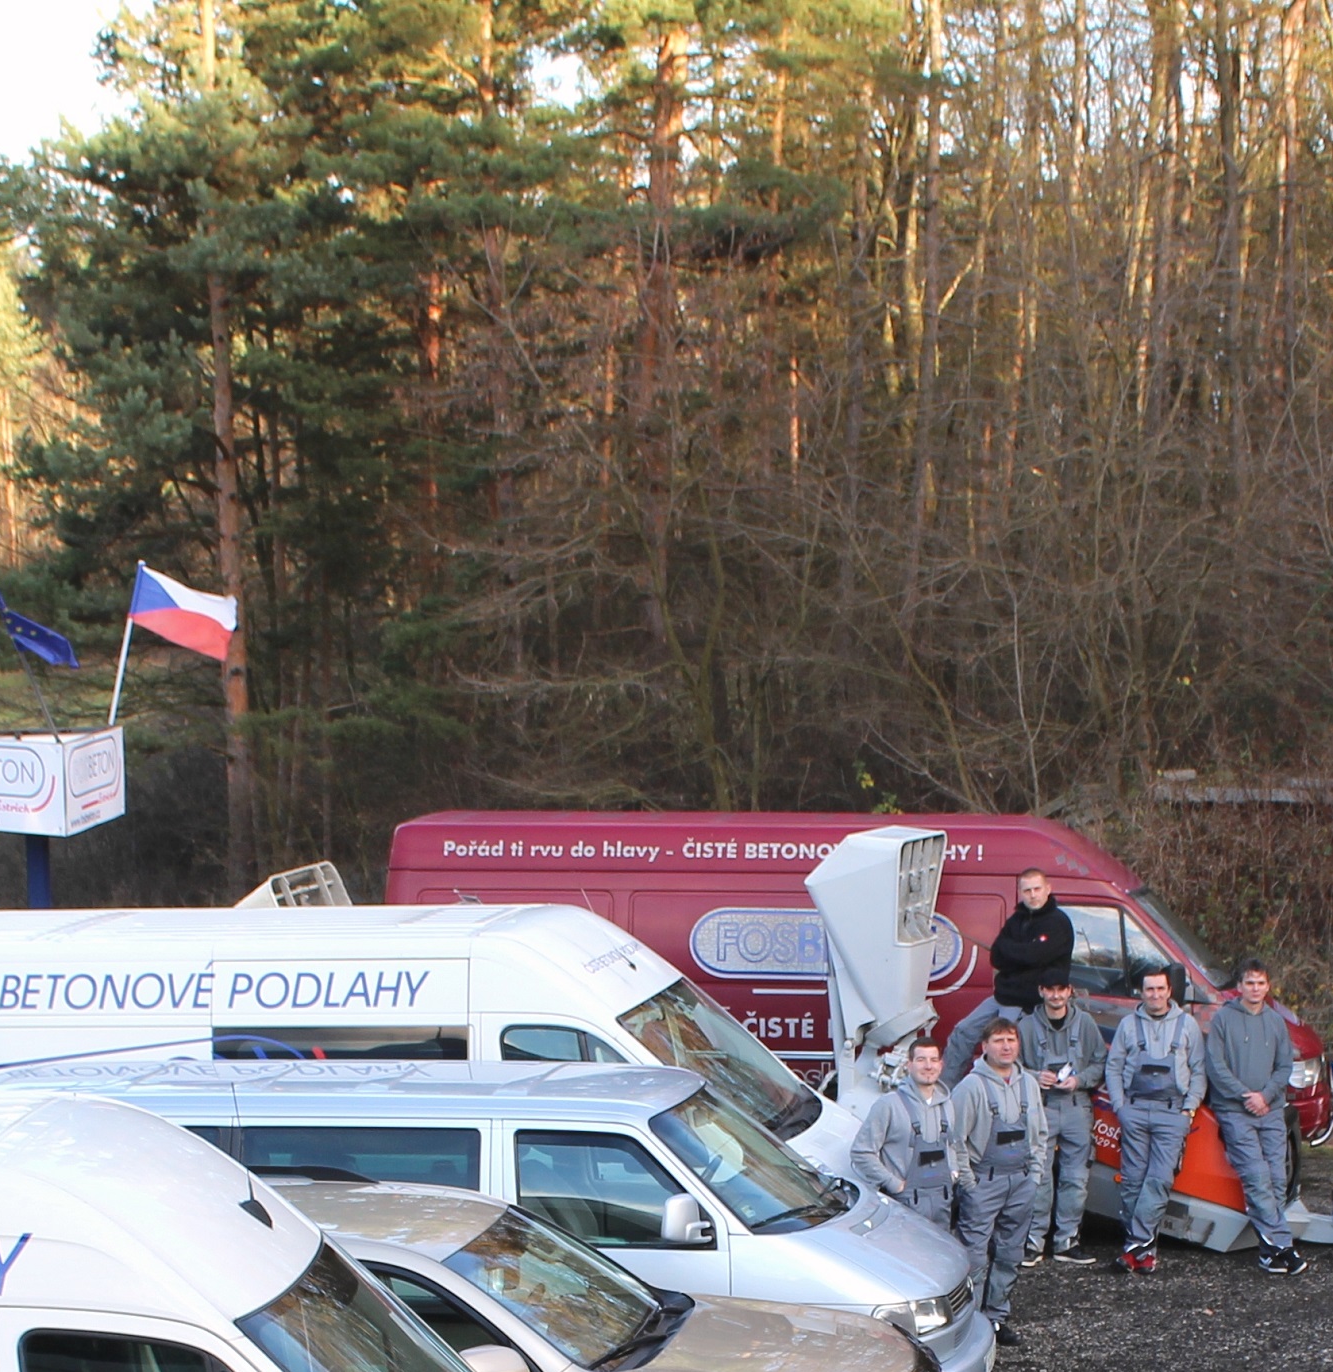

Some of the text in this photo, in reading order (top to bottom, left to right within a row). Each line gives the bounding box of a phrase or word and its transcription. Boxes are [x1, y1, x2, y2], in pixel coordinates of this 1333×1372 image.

[443, 839, 504, 857] Pořád
[510, 840, 524, 857] ti
[530, 844, 564, 858] rvu
[570, 840, 596, 858] do
[602, 840, 660, 862] hlavy
[682, 836, 737, 859] ČISTÉ
[227, 970, 431, 1010] PODLAHY
[745, 1010, 814, 1039] ČISTÉ
